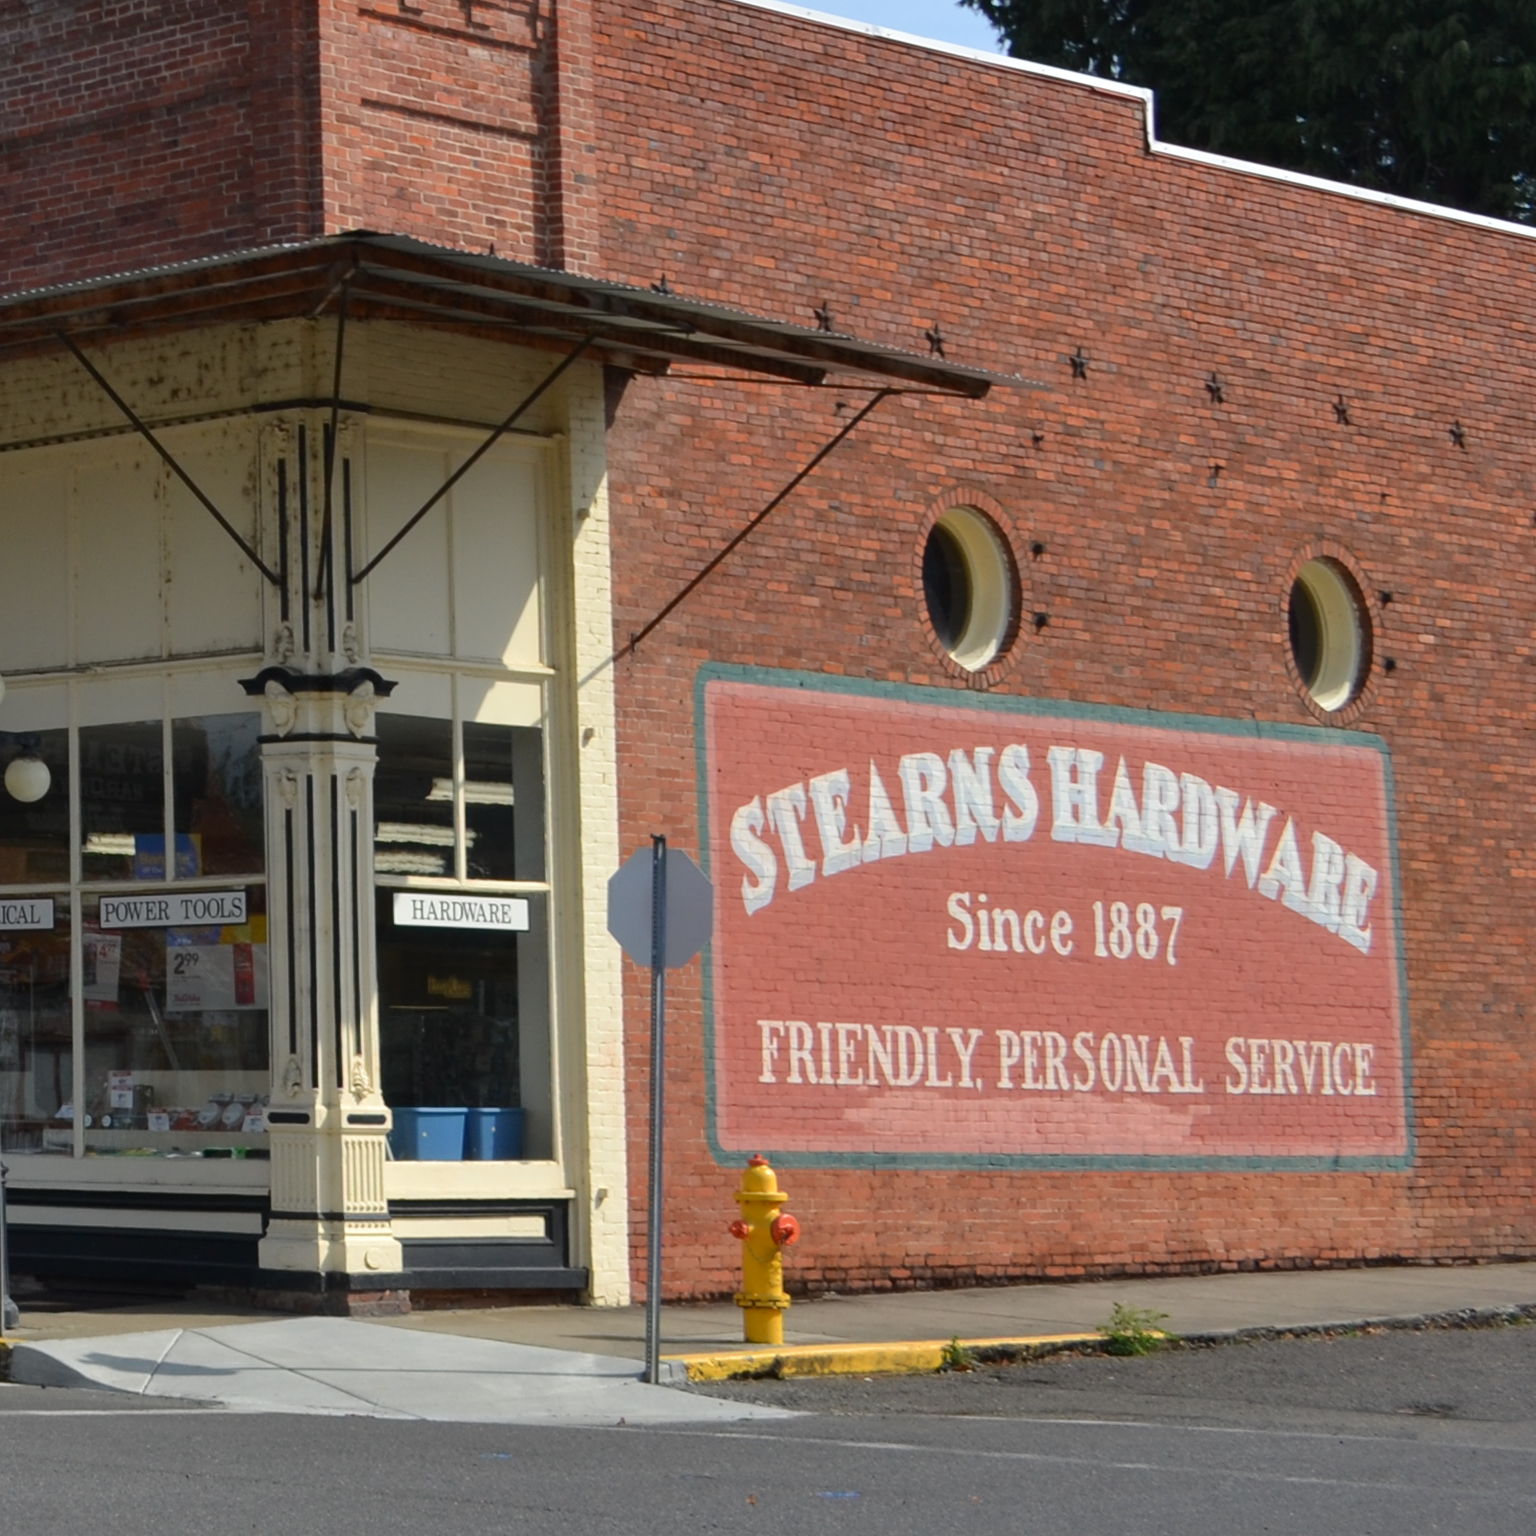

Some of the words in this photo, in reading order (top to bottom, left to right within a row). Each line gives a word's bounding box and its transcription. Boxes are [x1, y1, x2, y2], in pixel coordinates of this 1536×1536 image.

[729, 743, 1040, 917] STEARNS
[1046, 745, 1378, 955] HARDWARE
[103, 900, 171, 923] POWER
[180, 896, 244, 920] TOOLS
[411, 899, 512, 924] HARDWARE
[946, 891, 1074, 956] Since
[1091, 900, 1184, 967] 1887
[995, 1029, 1204, 1094] PERSONAL
[1224, 1036, 1377, 1096] SERVICE
